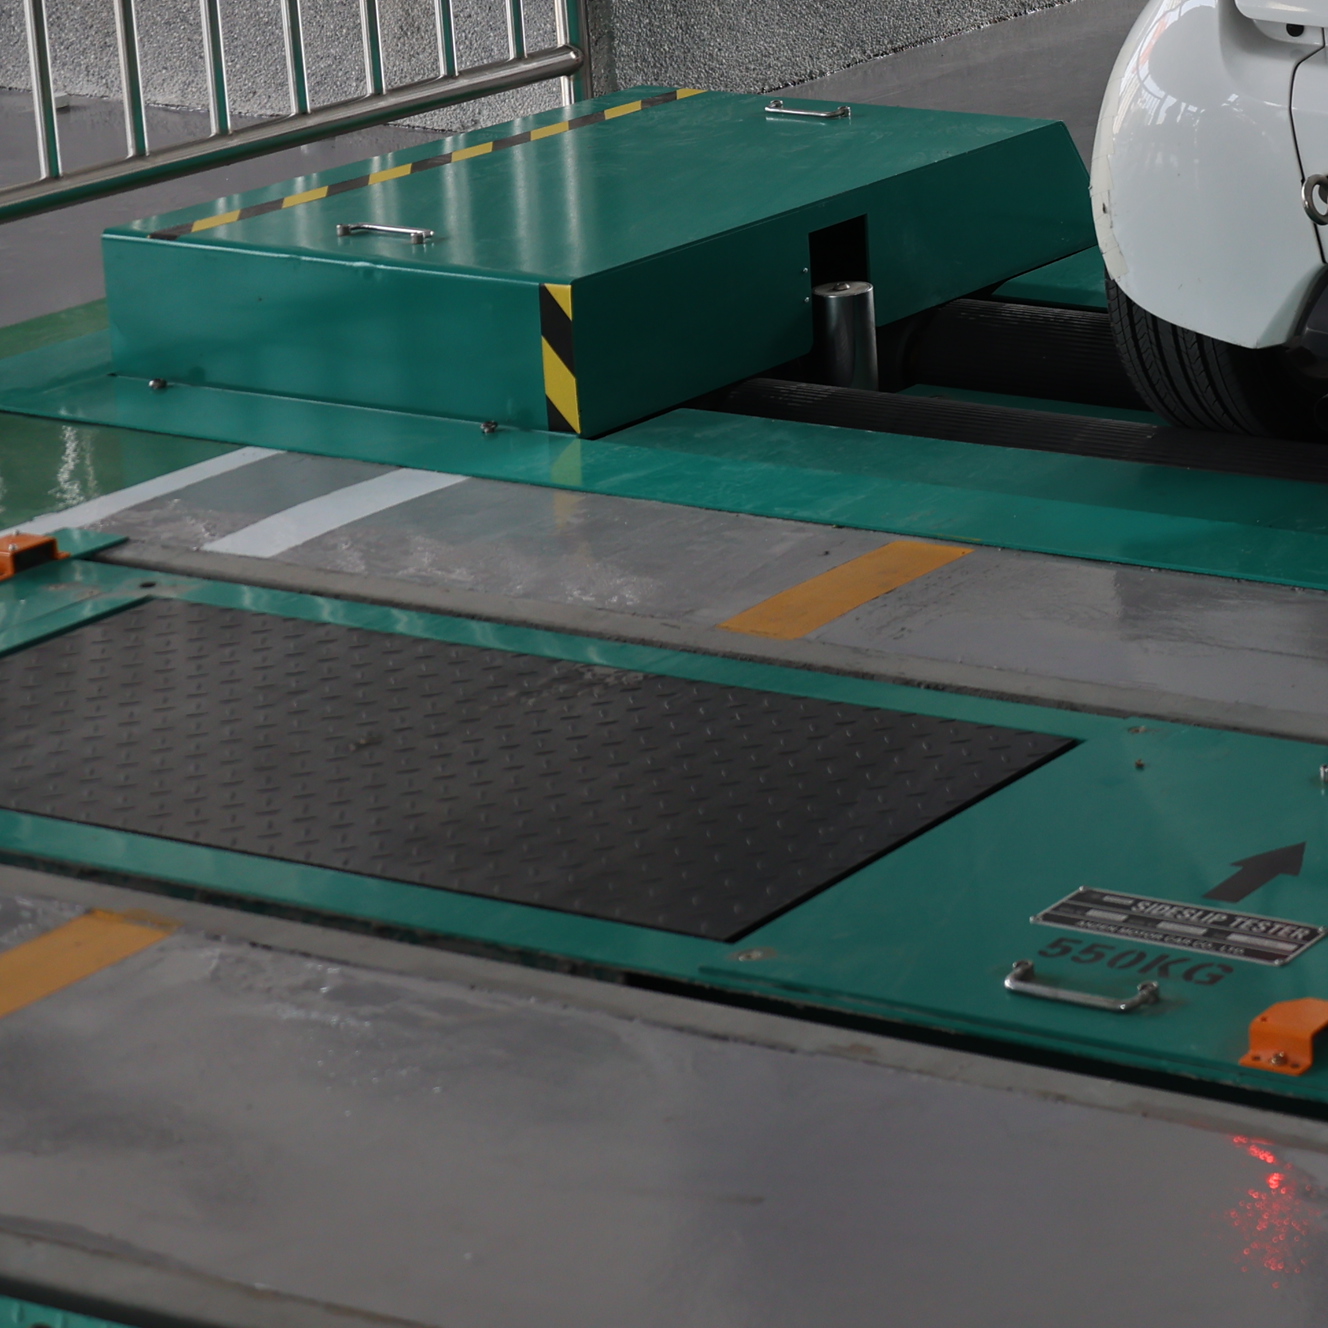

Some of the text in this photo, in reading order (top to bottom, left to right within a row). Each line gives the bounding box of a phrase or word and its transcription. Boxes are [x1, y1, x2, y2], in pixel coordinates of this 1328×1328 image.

[1131, 899, 1311, 941] SIDESLIP TESTER
[1038, 937, 1236, 987] 550KG
